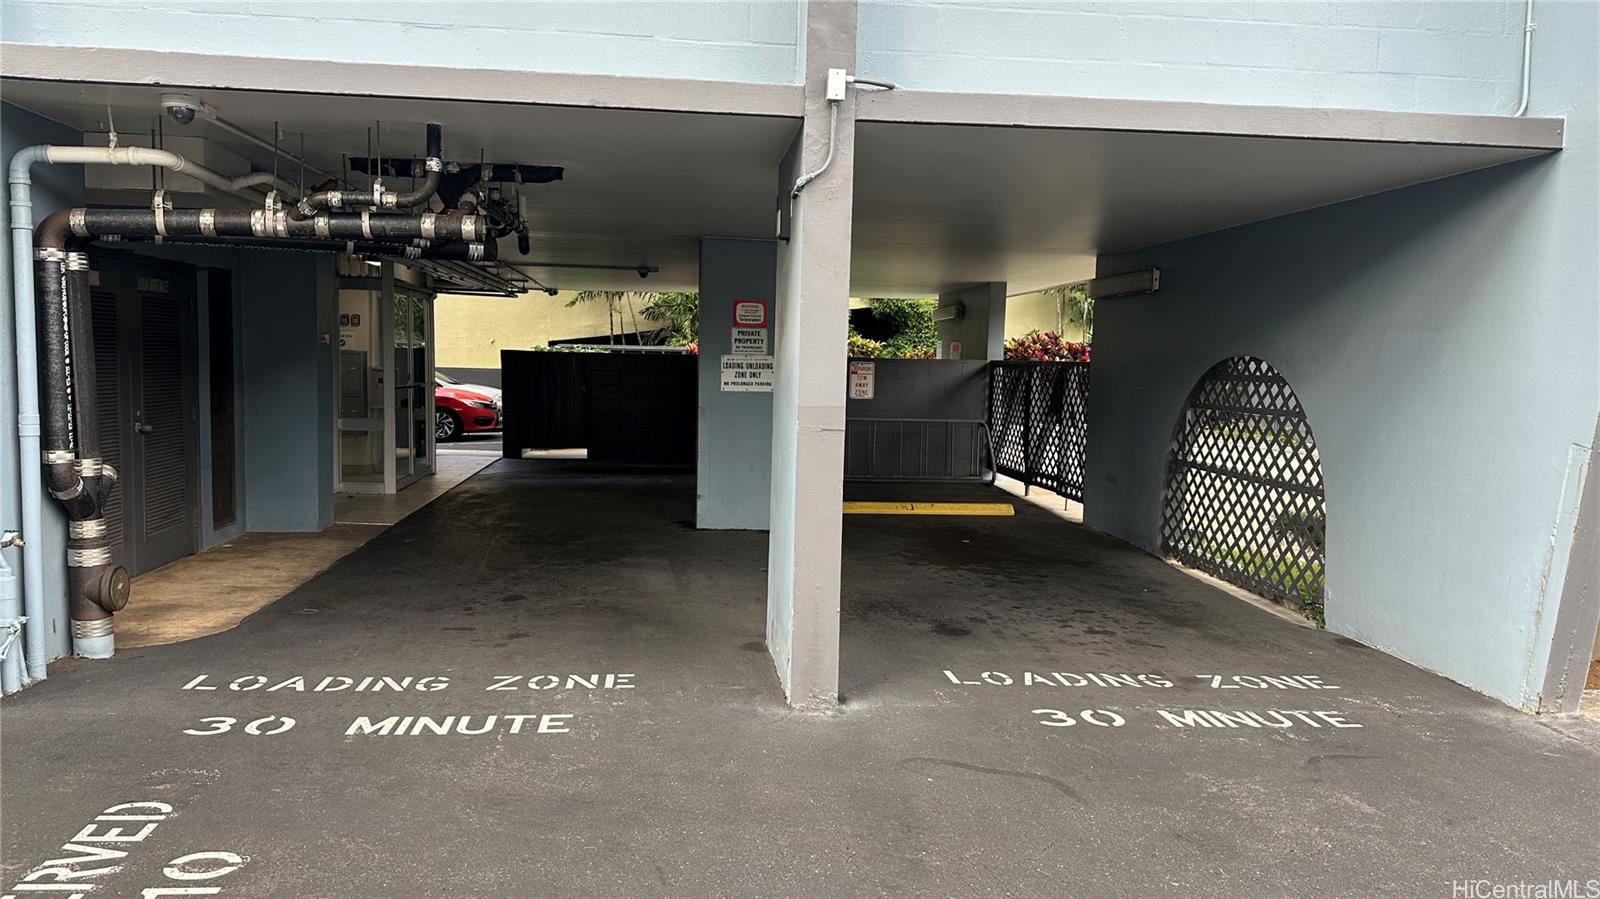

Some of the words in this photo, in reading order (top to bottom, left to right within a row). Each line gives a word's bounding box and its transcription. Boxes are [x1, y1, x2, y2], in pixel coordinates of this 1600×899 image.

[722, 362, 744, 370] LOADING
[745, 362, 774, 370] UNLOADING
[734, 371, 748, 379] ZONE
[749, 371, 762, 379] ONLY
[182, 674, 450, 692] LOADING
[486, 673, 635, 691] ZONE
[943, 670, 1174, 688] LOADING
[1196, 674, 1342, 690] ZONE
[183, 714, 296, 736] 30
[345, 713, 574, 736] MINUTE
[1031, 706, 1126, 728] 30
[1158, 708, 1364, 730] MINUTE
[0, 801, 174, 899] RVED
[141, 851, 246, 899] 10
